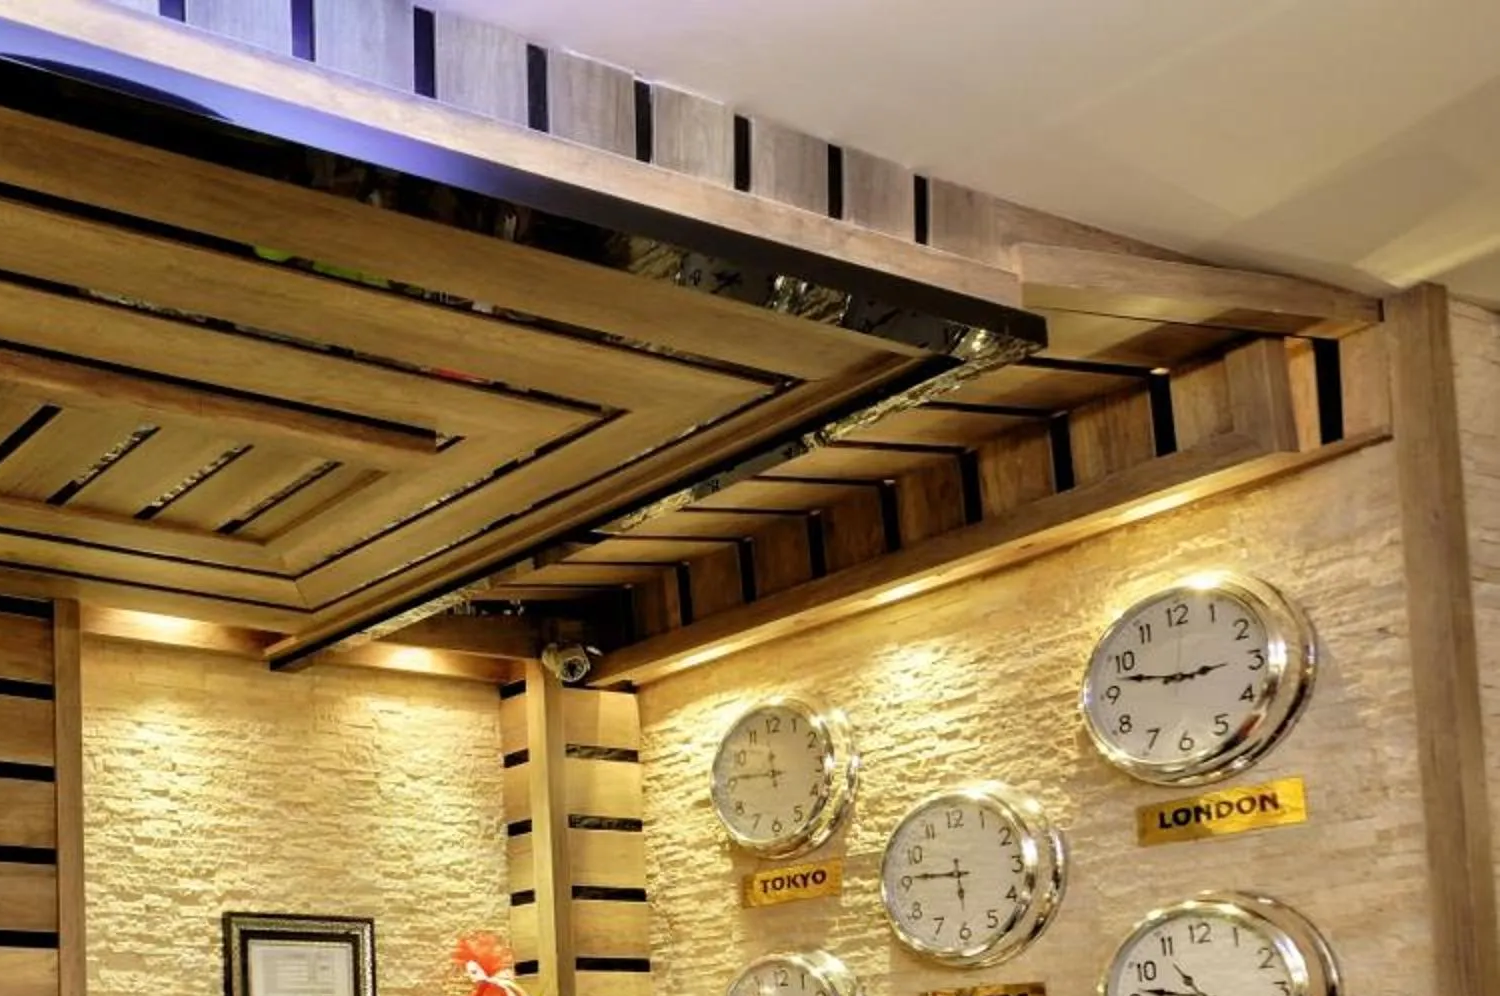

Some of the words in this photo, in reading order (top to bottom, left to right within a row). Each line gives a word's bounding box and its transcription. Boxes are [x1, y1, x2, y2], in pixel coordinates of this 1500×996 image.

[1166, 604, 1189, 627] 12
[1209, 604, 1215, 623] 1
[1139, 624, 1151, 644] 11
[1234, 619, 1250, 641] 2
[1115, 651, 1135, 672] 10
[1247, 649, 1265, 670] 3
[1106, 686, 1120, 704] 9
[1239, 683, 1254, 702] 4
[766, 717, 780, 734] 12
[791, 719, 796, 732] 1
[1119, 715, 1132, 734] 8
[1214, 714, 1229, 736] 5
[749, 731, 757, 744] 11
[807, 731, 817, 748] 2
[1147, 728, 1160, 749] 7
[1179, 730, 1194, 750] 6
[810, 783, 818, 796] 4
[735, 801, 744, 815] 8
[794, 806, 802, 823] 5
[1158, 792, 1280, 829] LONDON
[752, 814, 761, 830] 7
[772, 819, 782, 832] 6
[945, 809, 964, 829] 12
[980, 810, 985, 829] 1
[924, 824, 935, 840] 11
[998, 827, 1012, 846] 2
[907, 845, 923, 864] 10
[1011, 855, 1024, 873] 3
[760, 869, 827, 894] TOKYO
[901, 876, 913, 893] 9
[1005, 886, 1017, 902] 4
[911, 902, 923, 920] 8
[986, 910, 998, 928] 5
[933, 917, 944, 935] 7
[960, 922, 972, 940] 6
[1188, 922, 1211, 944] 12
[1160, 937, 1173, 956] 11
[1232, 927, 1239, 947] 1
[1258, 947, 1275, 969] 2
[773, 970, 788, 987] 12
[1137, 961, 1157, 981] 10
[801, 974, 805, 990] 1
